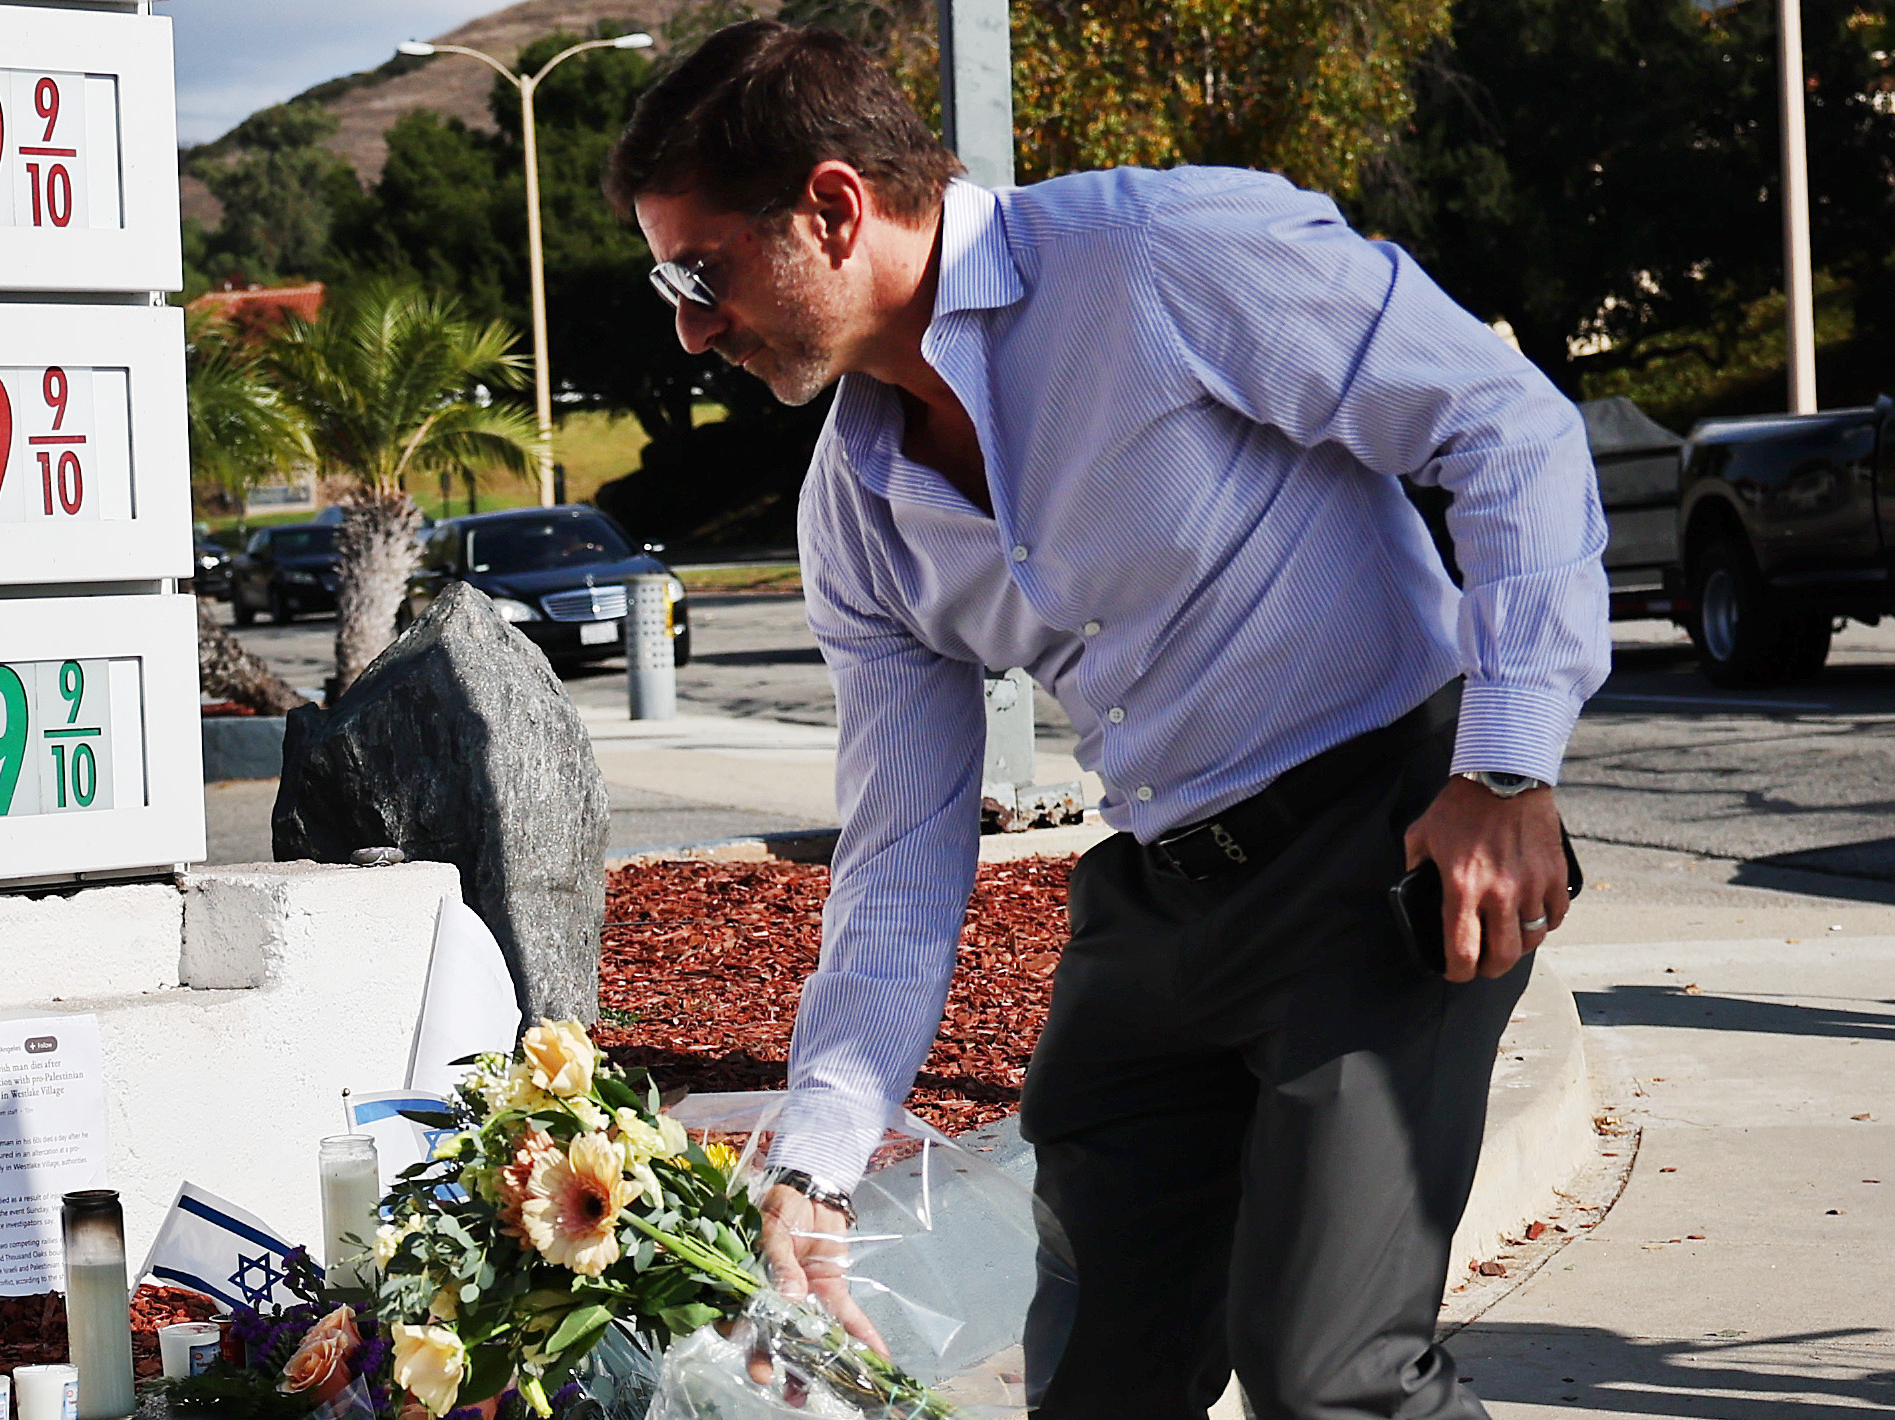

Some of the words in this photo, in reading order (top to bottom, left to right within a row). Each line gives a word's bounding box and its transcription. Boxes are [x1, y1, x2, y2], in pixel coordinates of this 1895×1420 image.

[33, 76, 61, 143] 9
[28, 160, 73, 228] 10
[42, 365, 69, 433] 9
[38, 450, 84, 517] 10
[58, 660, 85, 728] 9
[51, 741, 97, 809] 10
[1, 1091, 9, 1100] in
[11, 1088, 39, 1098] Westlake
[41, 1086, 65, 1097] Village
[12, 1064, 29, 1072] man
[30, 1061, 43, 1069] dies
[44, 1059, 61, 1068] after
[14, 1074, 31, 1084] with
[32, 1072, 84, 1086] pro-Palestinian
